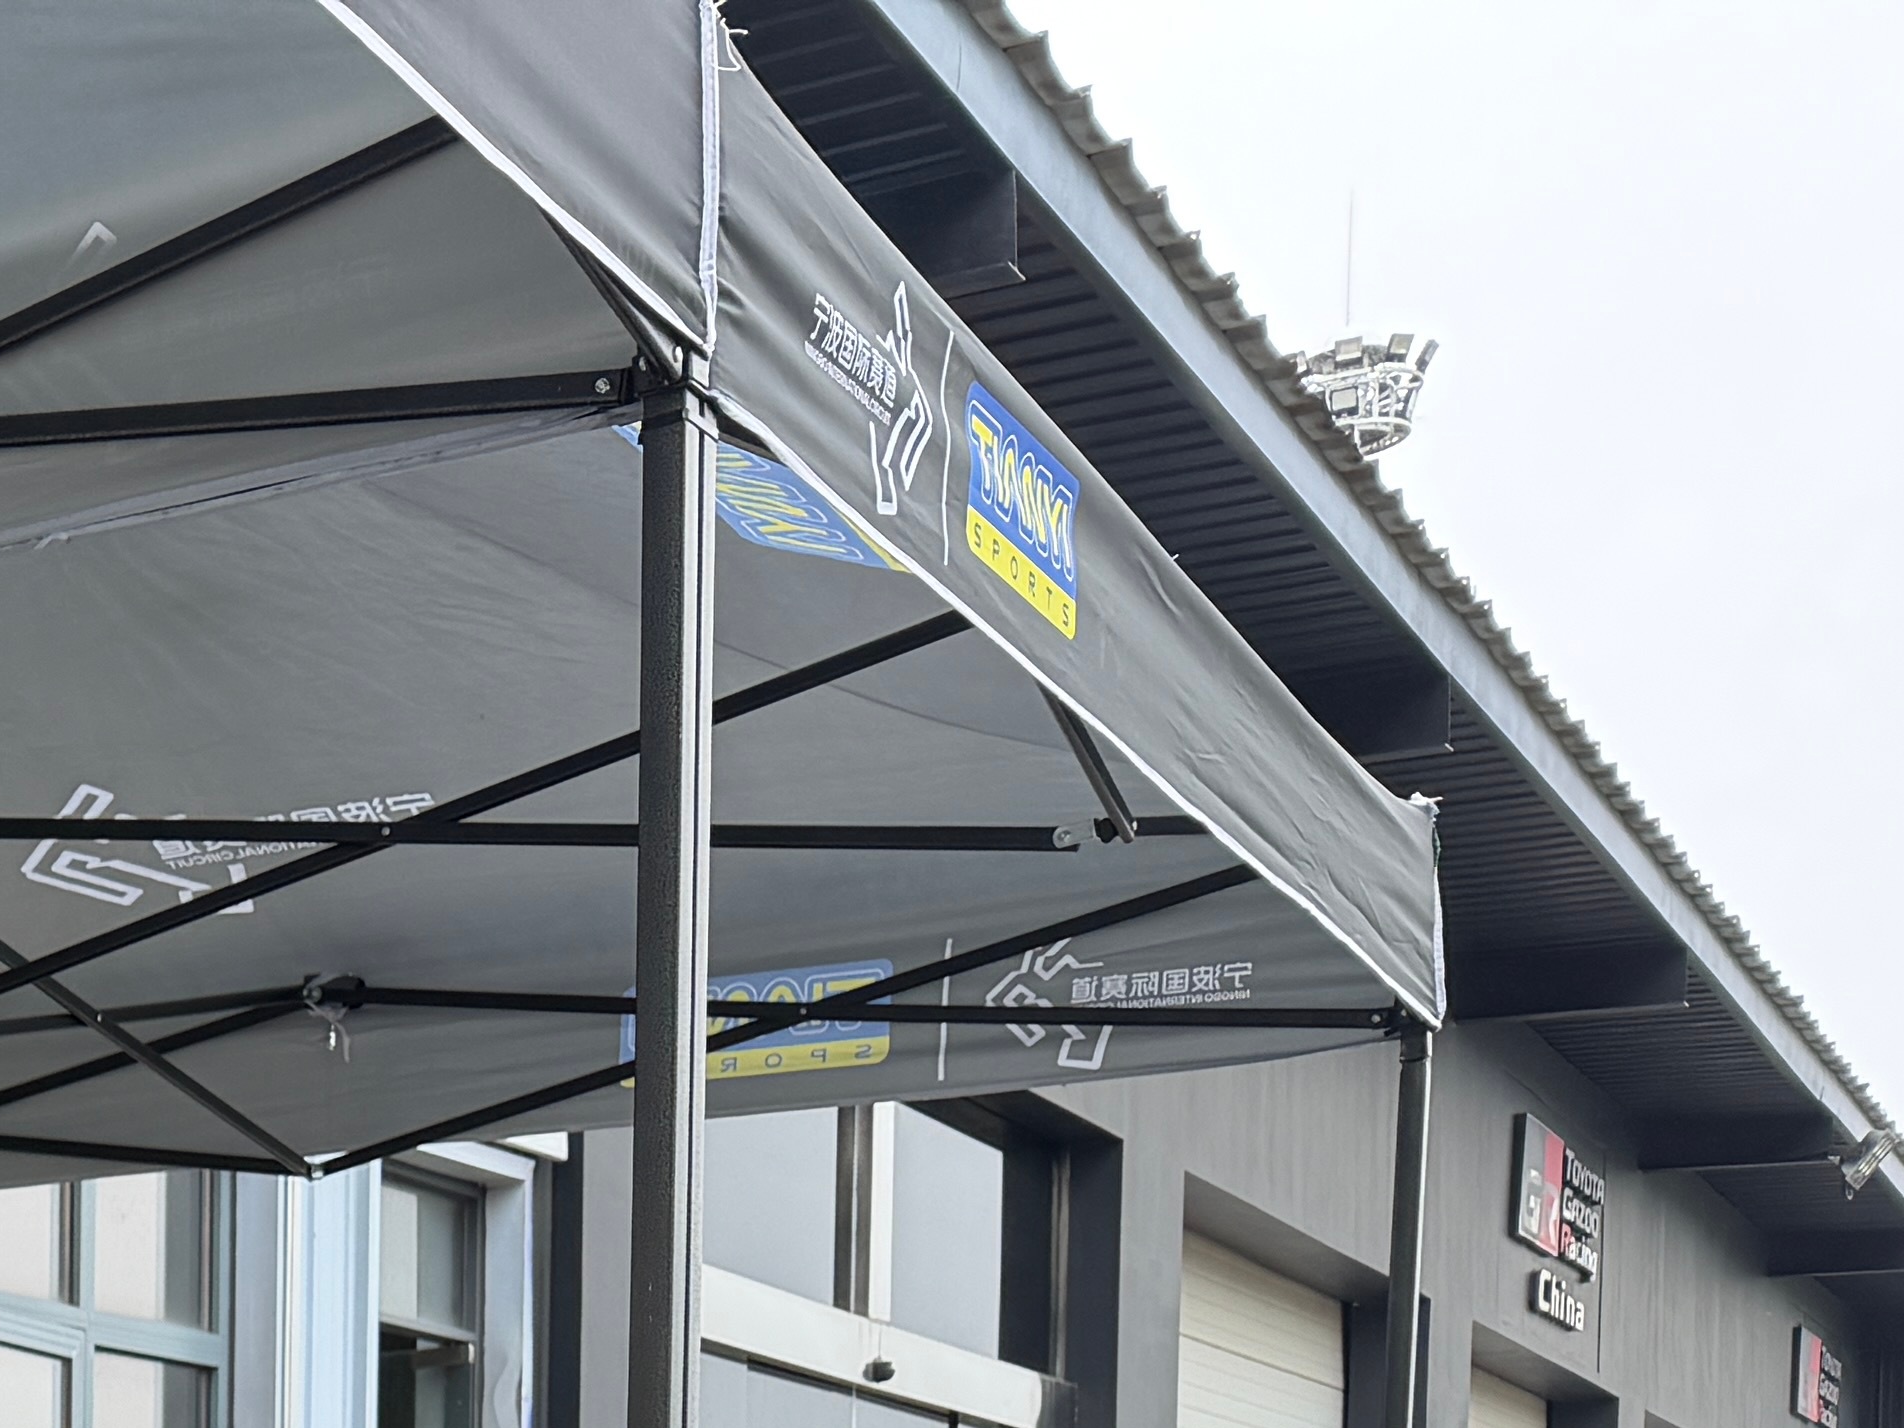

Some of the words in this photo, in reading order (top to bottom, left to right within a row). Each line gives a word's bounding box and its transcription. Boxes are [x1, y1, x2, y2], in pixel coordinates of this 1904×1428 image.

[973, 521, 1070, 627] SPORTS
[1565, 1147, 1605, 1205] TOYOTA
[1562, 1187, 1600, 1239] GAZOO
[1560, 1223, 1599, 1282] Racing
[1538, 1268, 1585, 1331] China
